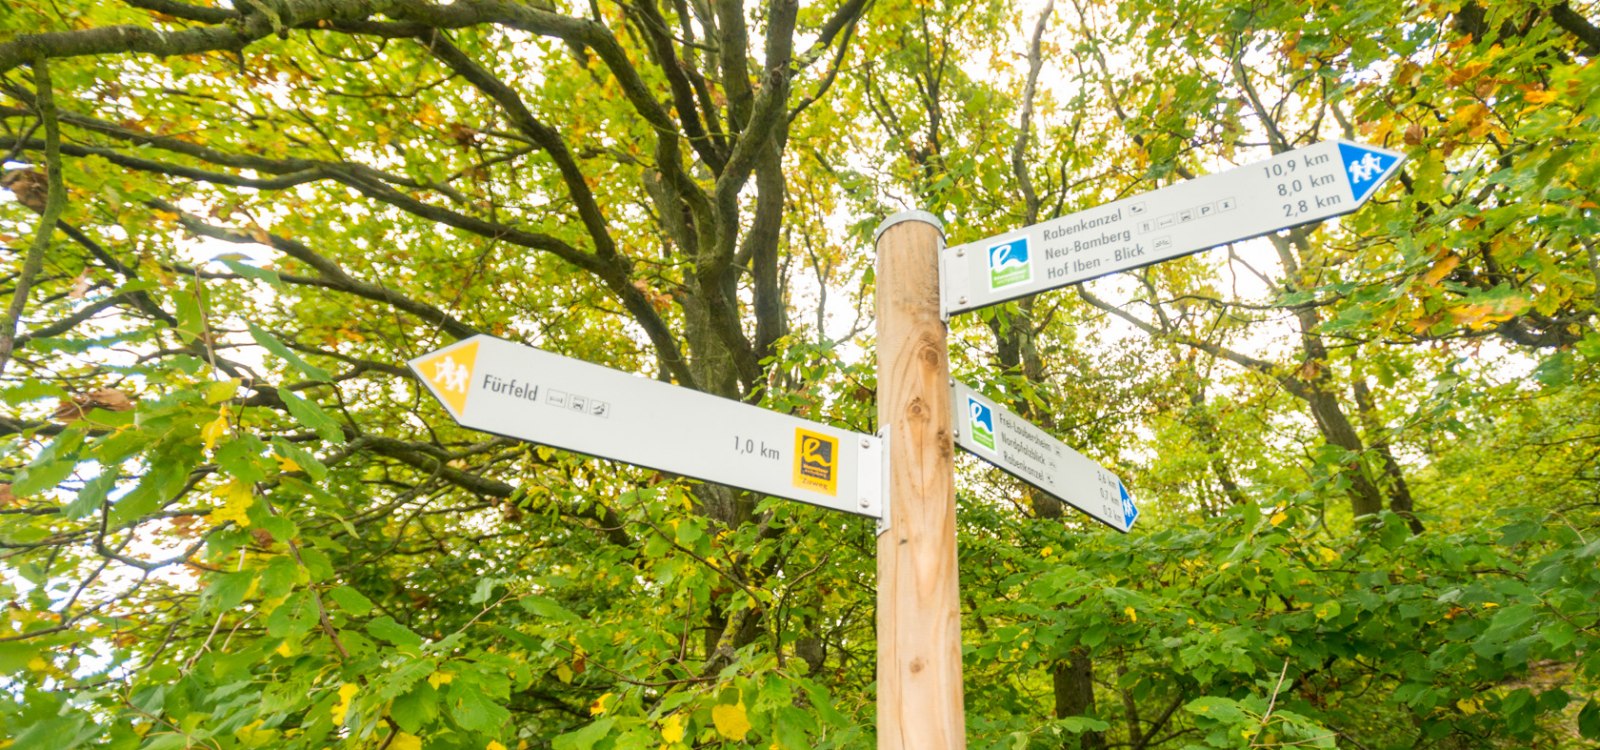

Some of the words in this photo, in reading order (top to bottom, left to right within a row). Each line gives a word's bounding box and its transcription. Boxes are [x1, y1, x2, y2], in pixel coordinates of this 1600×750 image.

[1263, 158, 1297, 180] 10,9
[1304, 151, 1330, 169] km
[1277, 179, 1303, 197] 8,0
[1311, 171, 1336, 188] km
[1283, 198, 1310, 219] 2,8
[1316, 191, 1342, 210] km
[1042, 208, 1123, 242] Rabenkanzel
[1044, 227, 1132, 261] Neu-Bamberg
[1047, 261, 1070, 280] Hof
[1073, 256, 1102, 274] Iben
[1114, 243, 1145, 263] Blick
[482, 373, 539, 402] Fürfeld
[998, 413, 1052, 452] Frei-Laubersheim
[734, 435, 754, 455] 1,0
[760, 440, 780, 460] km
[1001, 431, 1047, 466] Nordpfalzblick
[1003, 450, 1045, 481] Rabenkanzel
[1108, 476, 1117, 489] km
[1111, 493, 1120, 507] km
[1113, 510, 1123, 523] km
